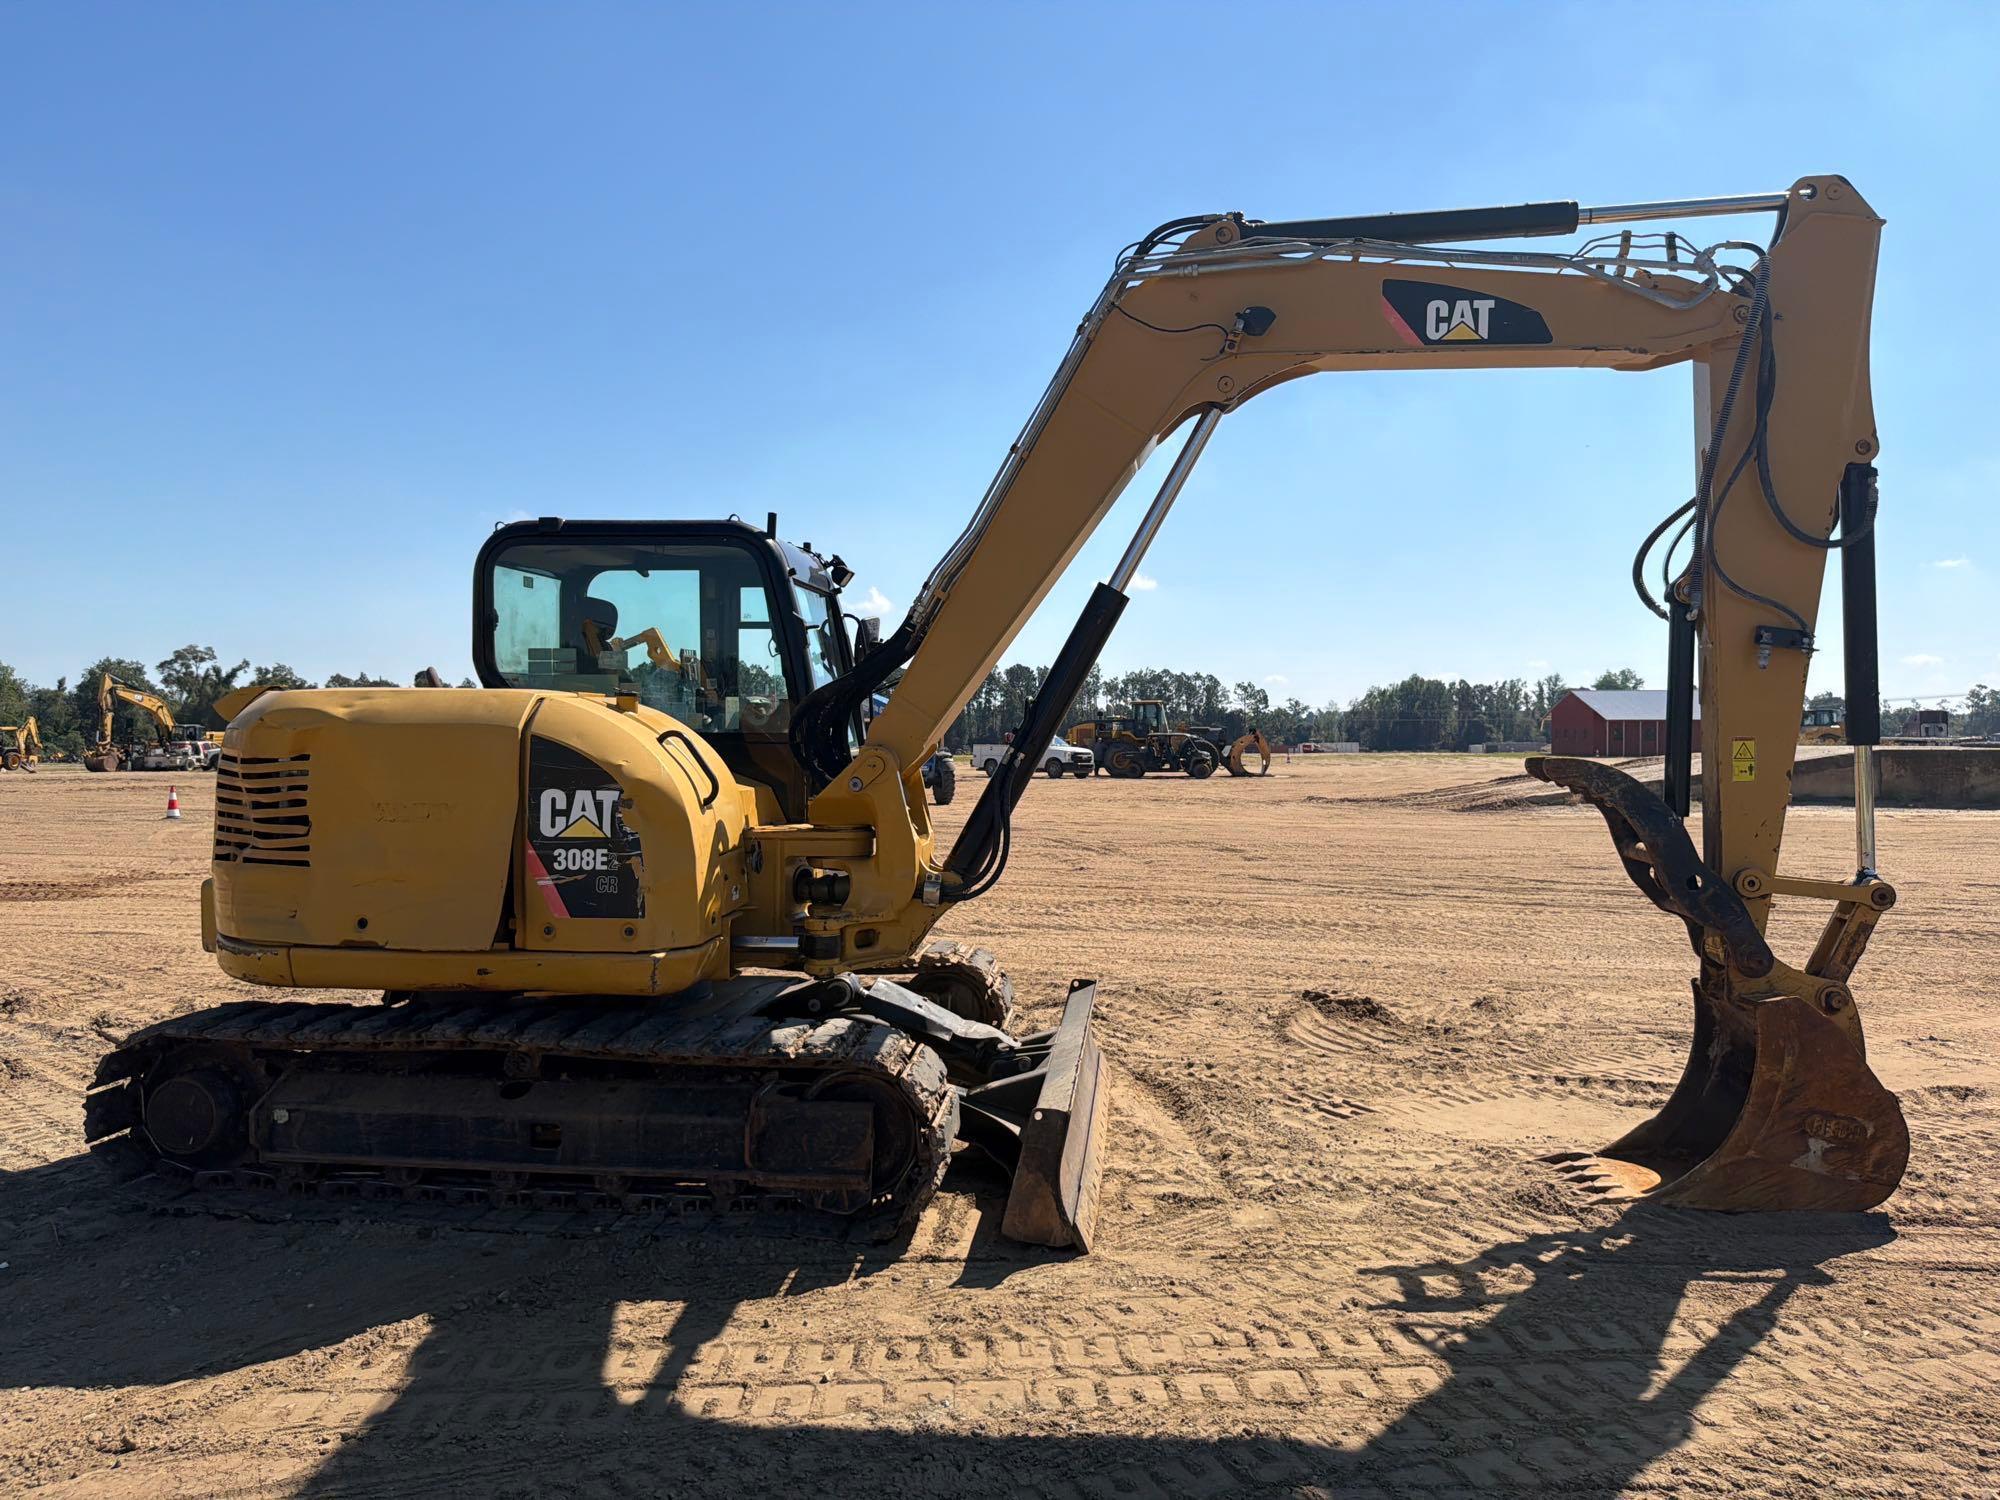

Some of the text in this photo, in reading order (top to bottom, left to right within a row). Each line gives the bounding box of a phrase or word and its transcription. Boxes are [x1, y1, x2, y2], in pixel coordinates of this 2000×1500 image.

[1426, 300, 1495, 340] CAT
[540, 789, 619, 838] CAT
[597, 875, 618, 894] CR
